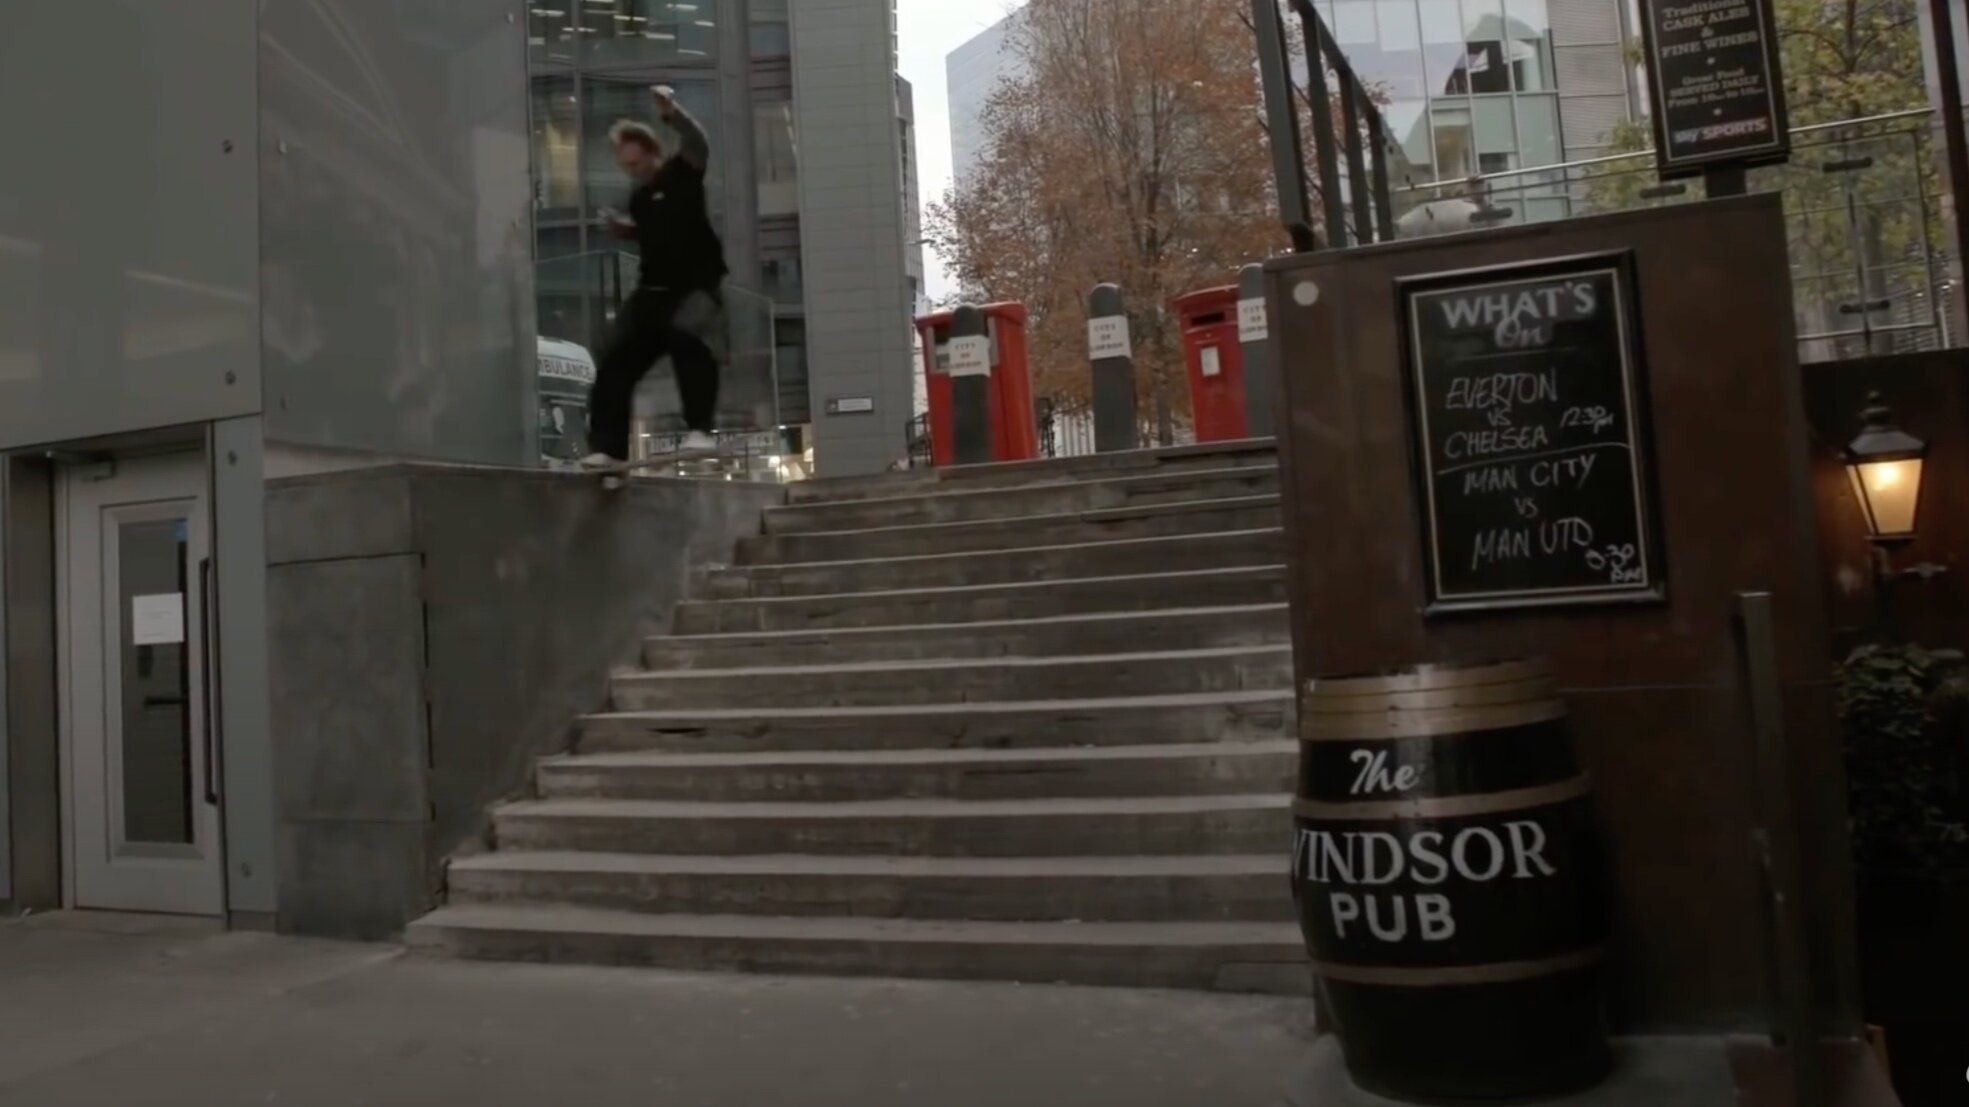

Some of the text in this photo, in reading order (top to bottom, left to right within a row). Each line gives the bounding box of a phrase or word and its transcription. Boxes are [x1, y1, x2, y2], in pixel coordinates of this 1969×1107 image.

[1662, 6, 1749, 31] CASK ALES
[1661, 31, 1758, 58] FINE WINES
[1701, 116, 1768, 140] SPORTS
[1441, 282, 1596, 328] WHAT'S
[1446, 368, 1557, 409] EVERTON
[1445, 426, 1549, 458] CHELSEA
[1463, 453, 1597, 495] MAN CITY
[1472, 517, 1594, 571] MAN UTD
[1350, 749, 1420, 794] The
[1329, 892, 1456, 942] PUB
